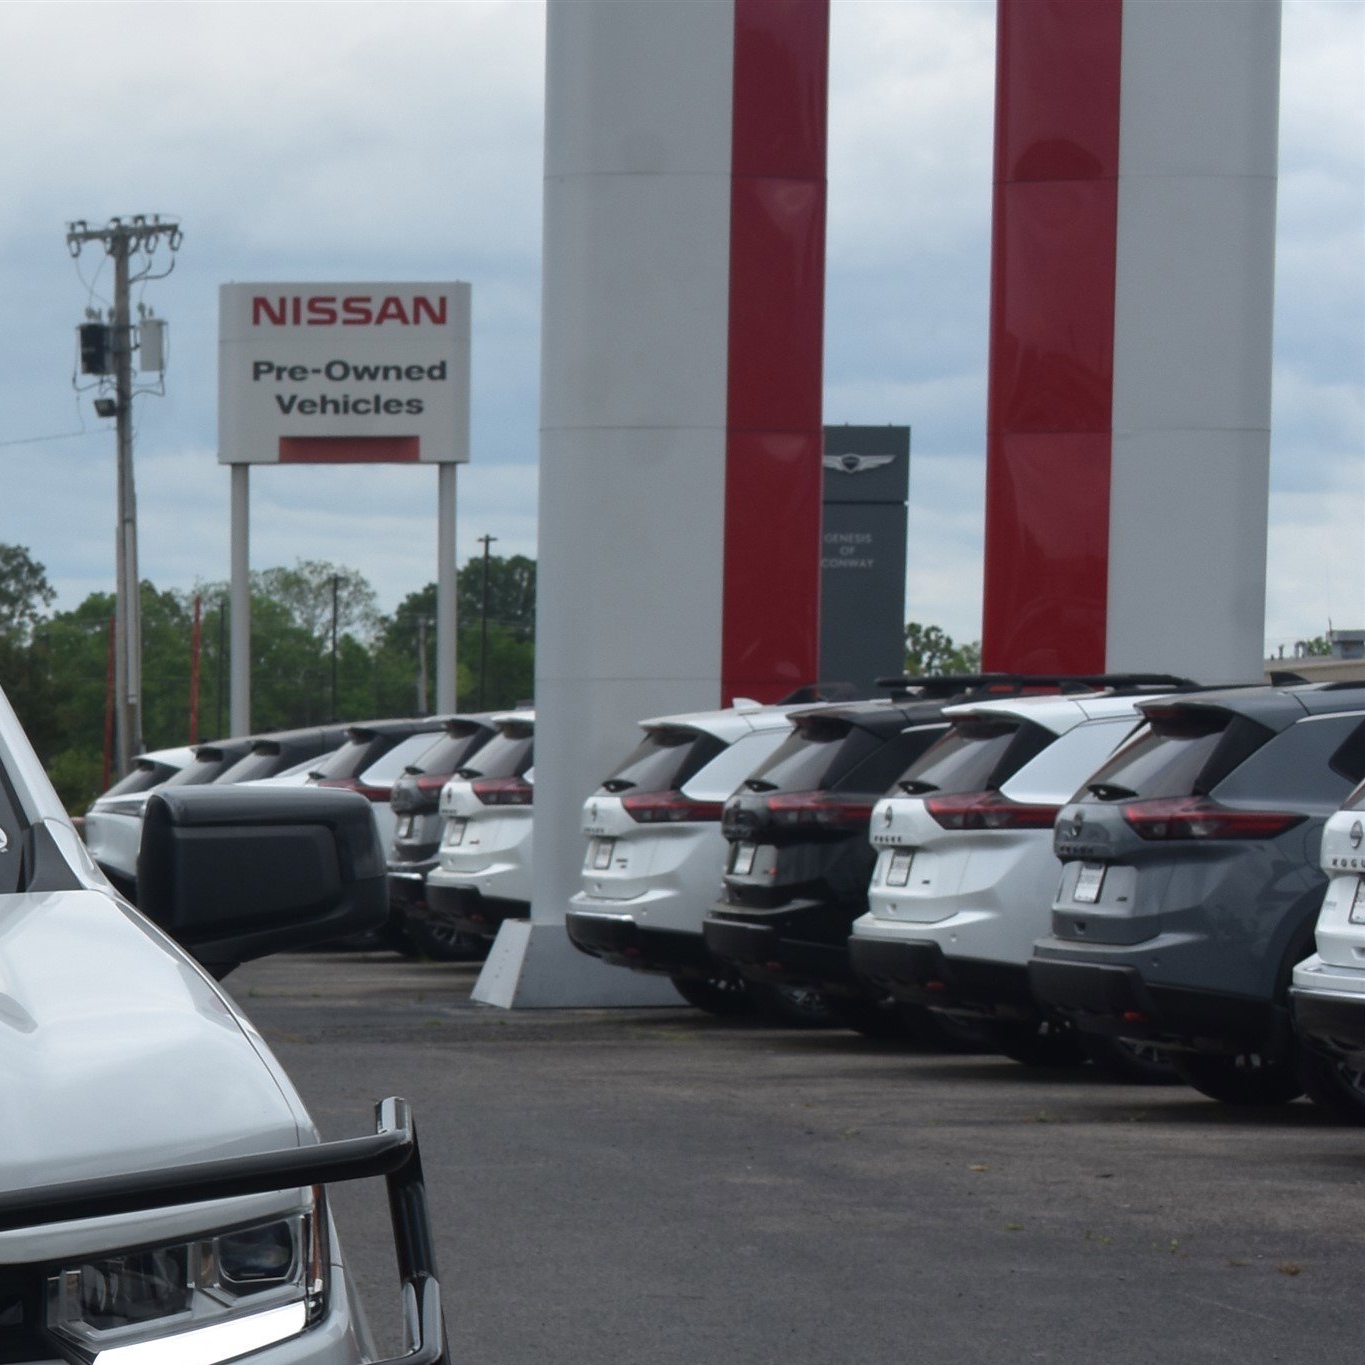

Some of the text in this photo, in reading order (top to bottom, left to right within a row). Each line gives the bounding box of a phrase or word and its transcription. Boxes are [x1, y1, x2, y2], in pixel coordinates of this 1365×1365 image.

[252, 296, 447, 326] NISSAN
[252, 360, 447, 382] Pre-Owned
[275, 394, 424, 416] Vehicles
[824, 533, 872, 544] GENESIS
